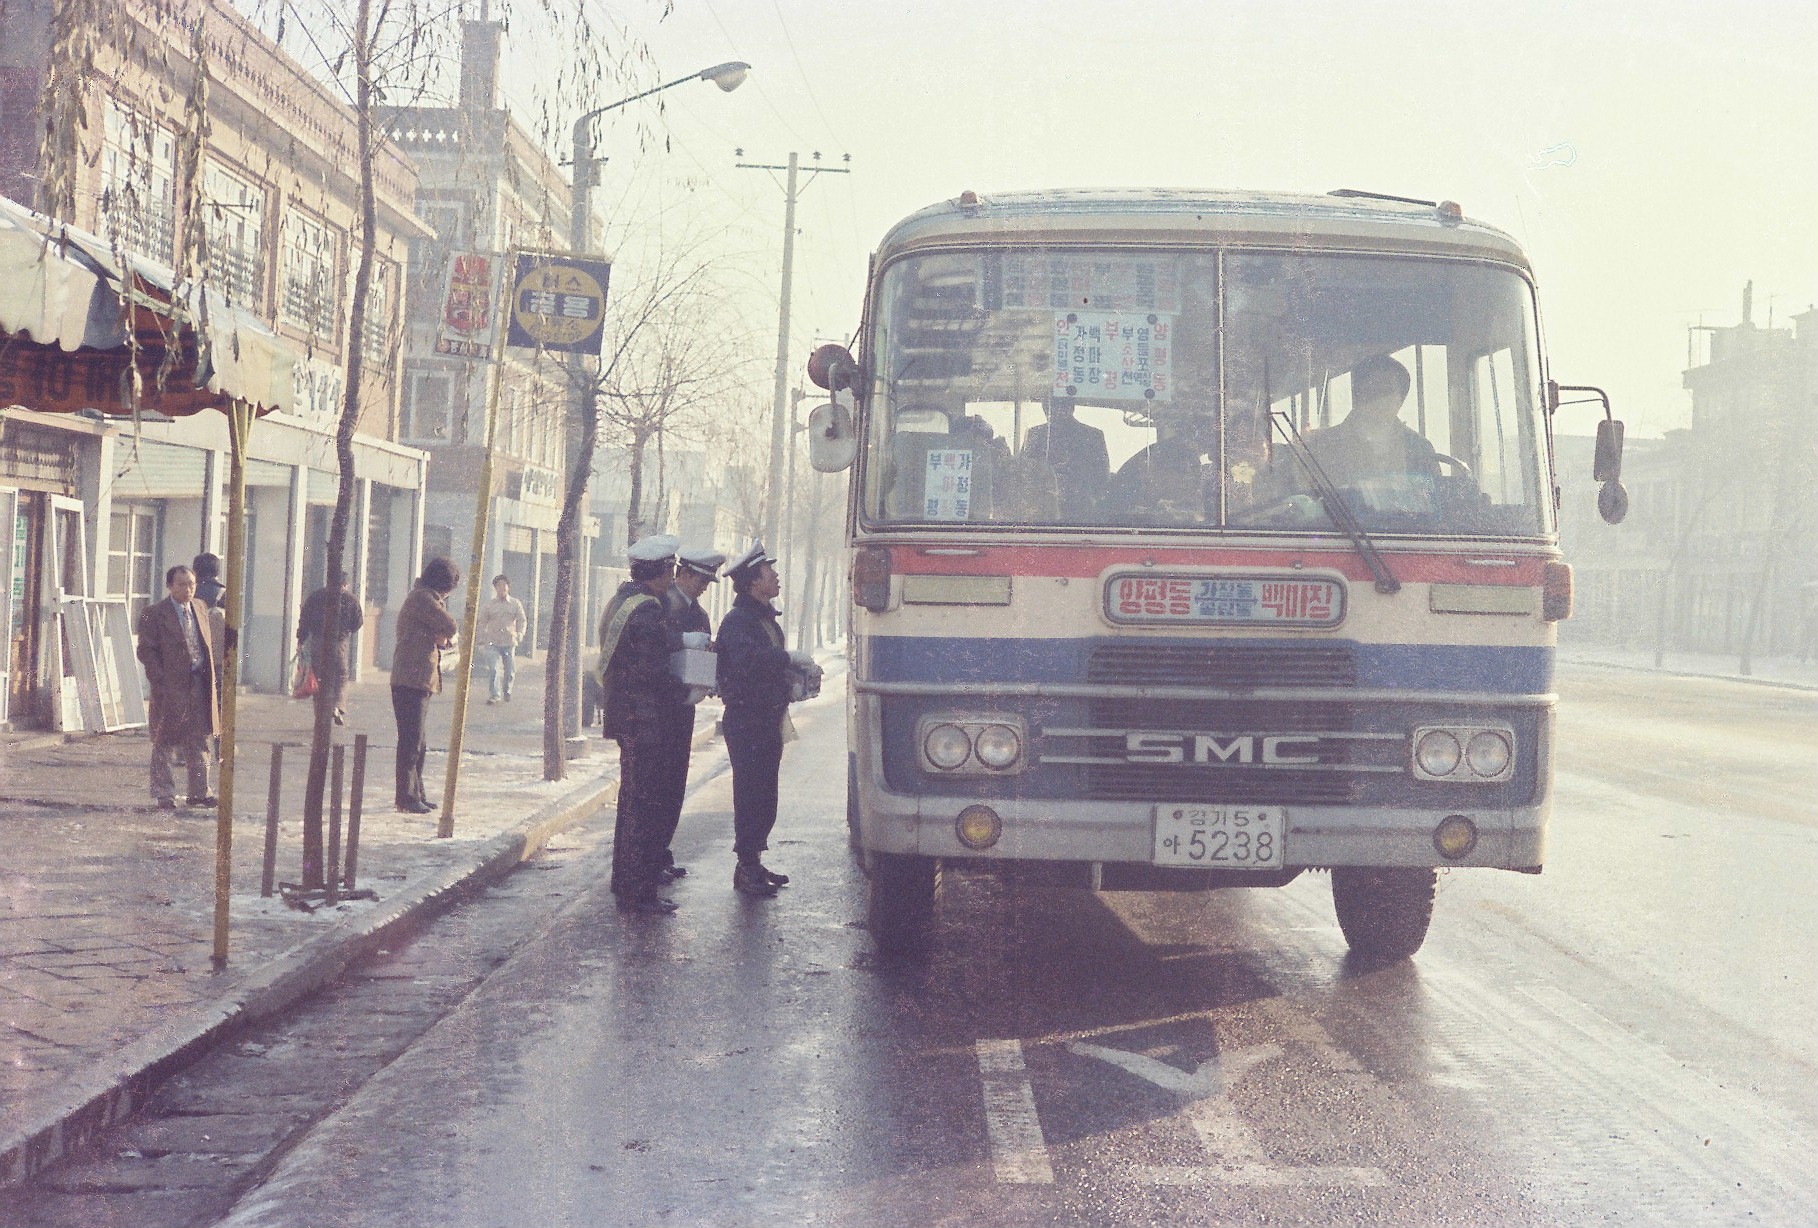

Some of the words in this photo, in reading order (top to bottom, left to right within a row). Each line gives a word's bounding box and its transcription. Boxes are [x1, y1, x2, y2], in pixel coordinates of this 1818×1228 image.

[1119, 579, 1192, 615] 양평동
[1261, 583, 1332, 619] 백마장
[1126, 733, 1320, 765] SMC
